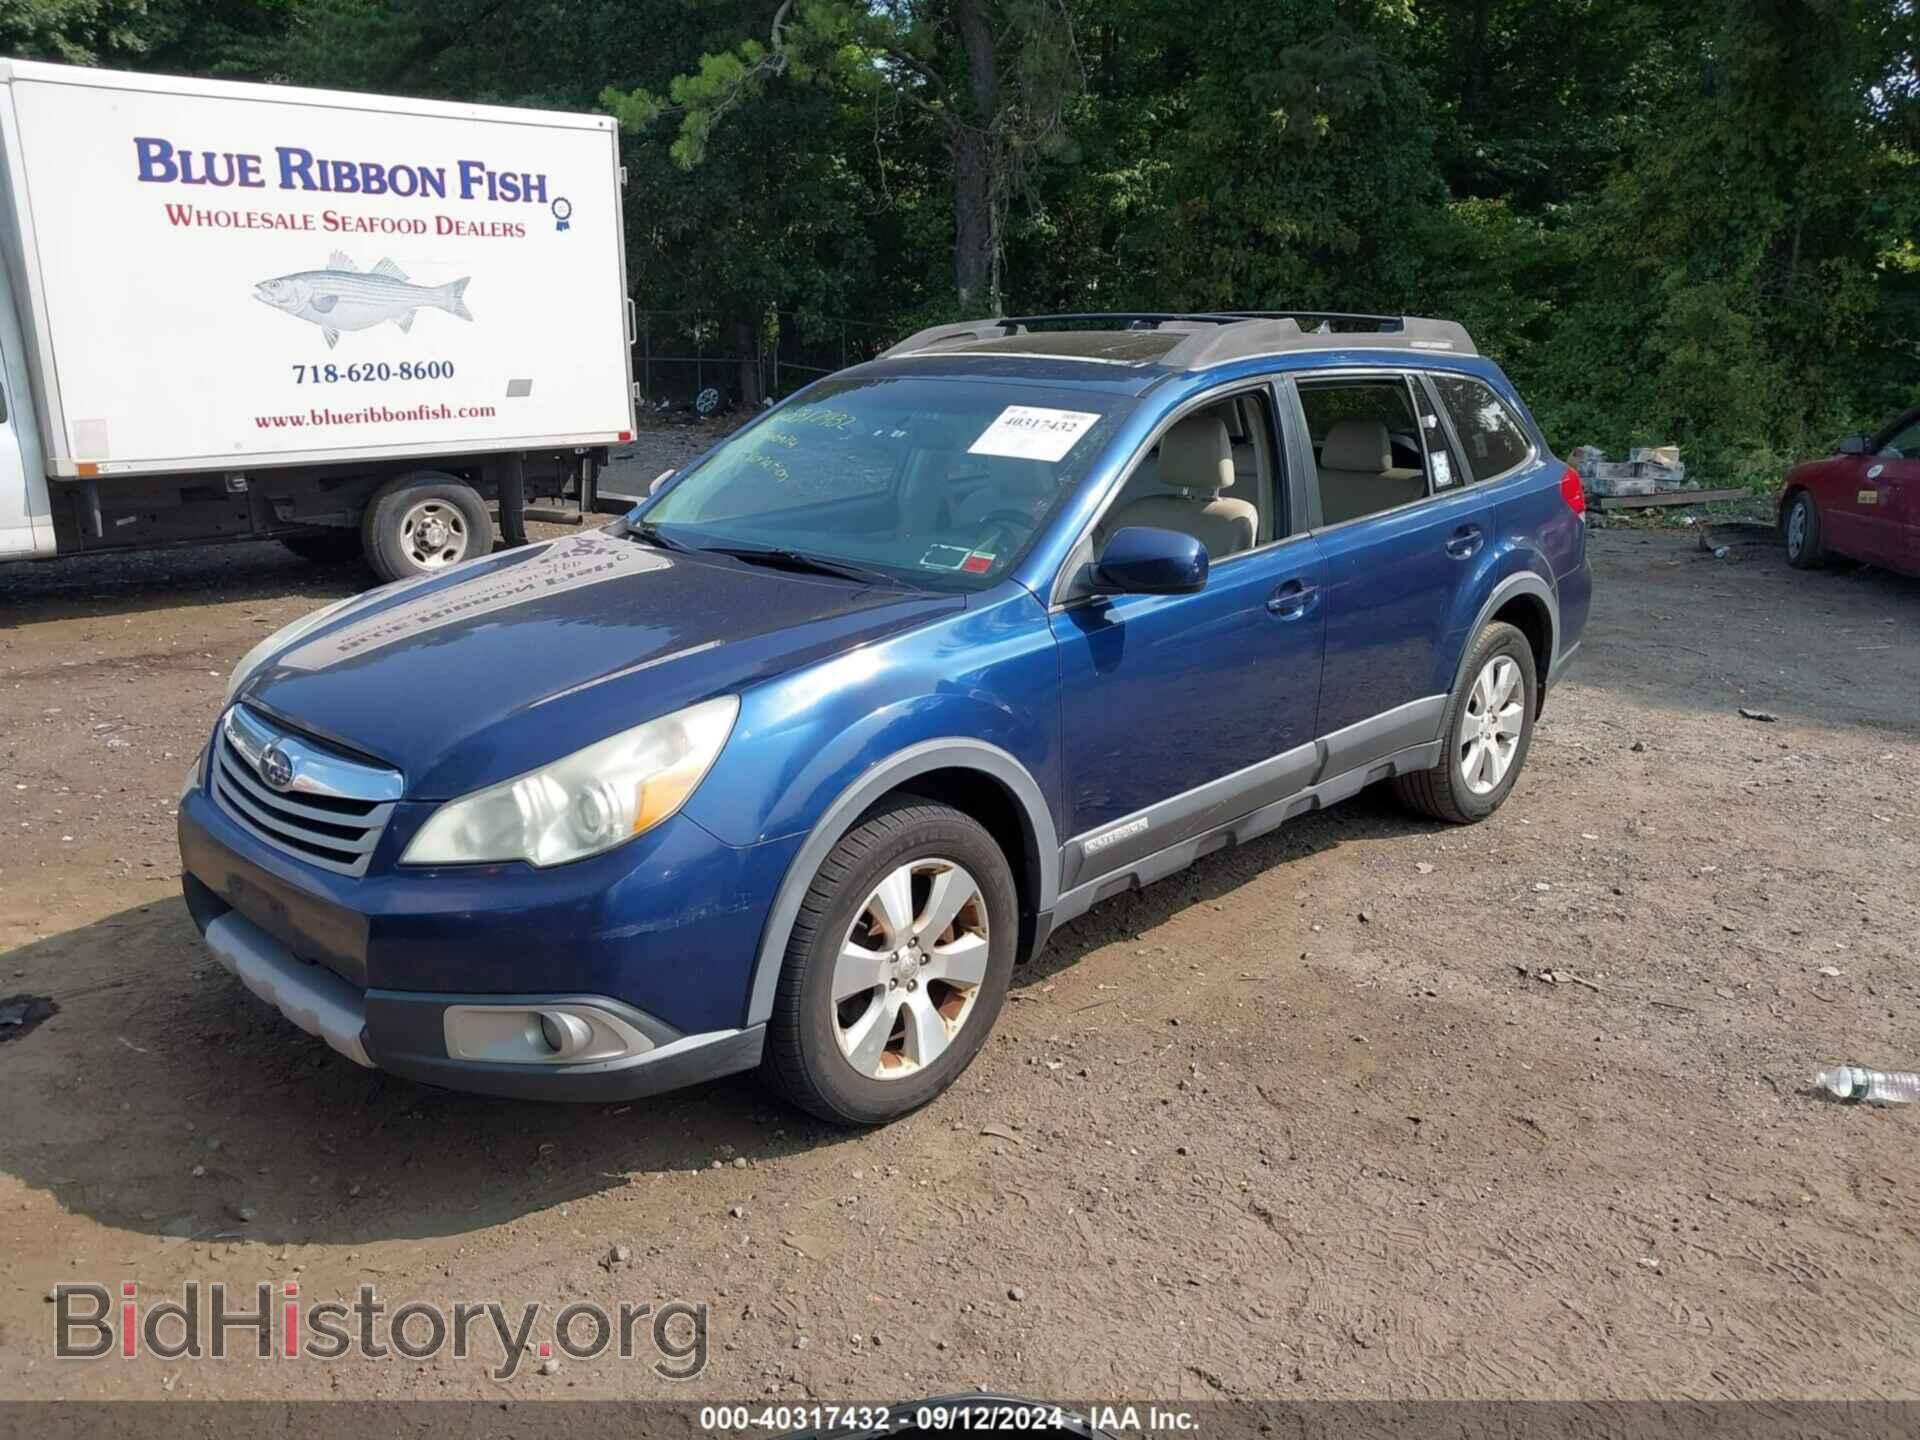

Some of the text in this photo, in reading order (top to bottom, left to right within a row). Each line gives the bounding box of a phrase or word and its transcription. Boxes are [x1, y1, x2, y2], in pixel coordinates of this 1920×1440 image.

[133, 136, 548, 204] BLUE RIBBON FISH
[165, 204, 526, 238] WHOLESALE SEAFOOD DEALERS
[293, 360, 454, 385] 718-620-8600
[255, 403, 496, 429] www.blueribbonfish.com
[1005, 417, 1078, 433] 40317432
